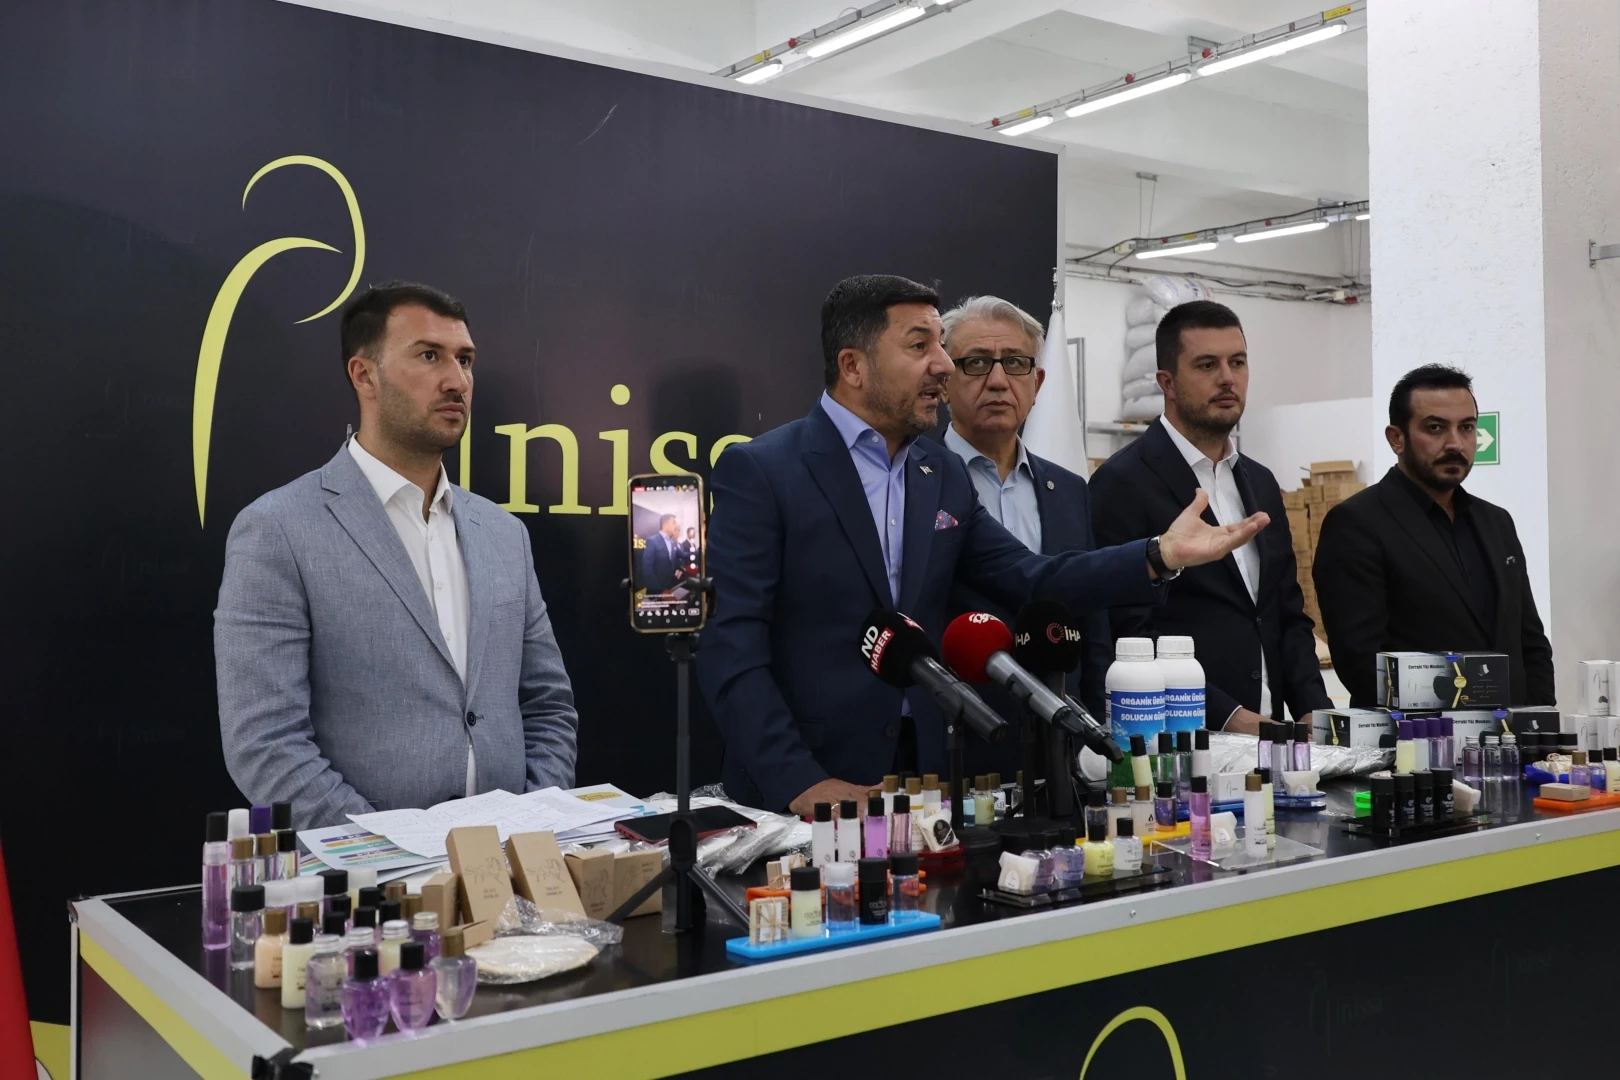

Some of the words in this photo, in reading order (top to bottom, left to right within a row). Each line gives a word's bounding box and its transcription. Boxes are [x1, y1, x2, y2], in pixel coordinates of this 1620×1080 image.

[1064, 625, 1081, 642] İHA
[861, 625, 879, 659] ND
[870, 630, 892, 671] HABER
[1121, 697, 1152, 705] ORGANİK
[1165, 693, 1191, 702] RGANİK
[1121, 713, 1153, 722] SOLUCAN
[1165, 709, 1192, 718] OLUCAN
